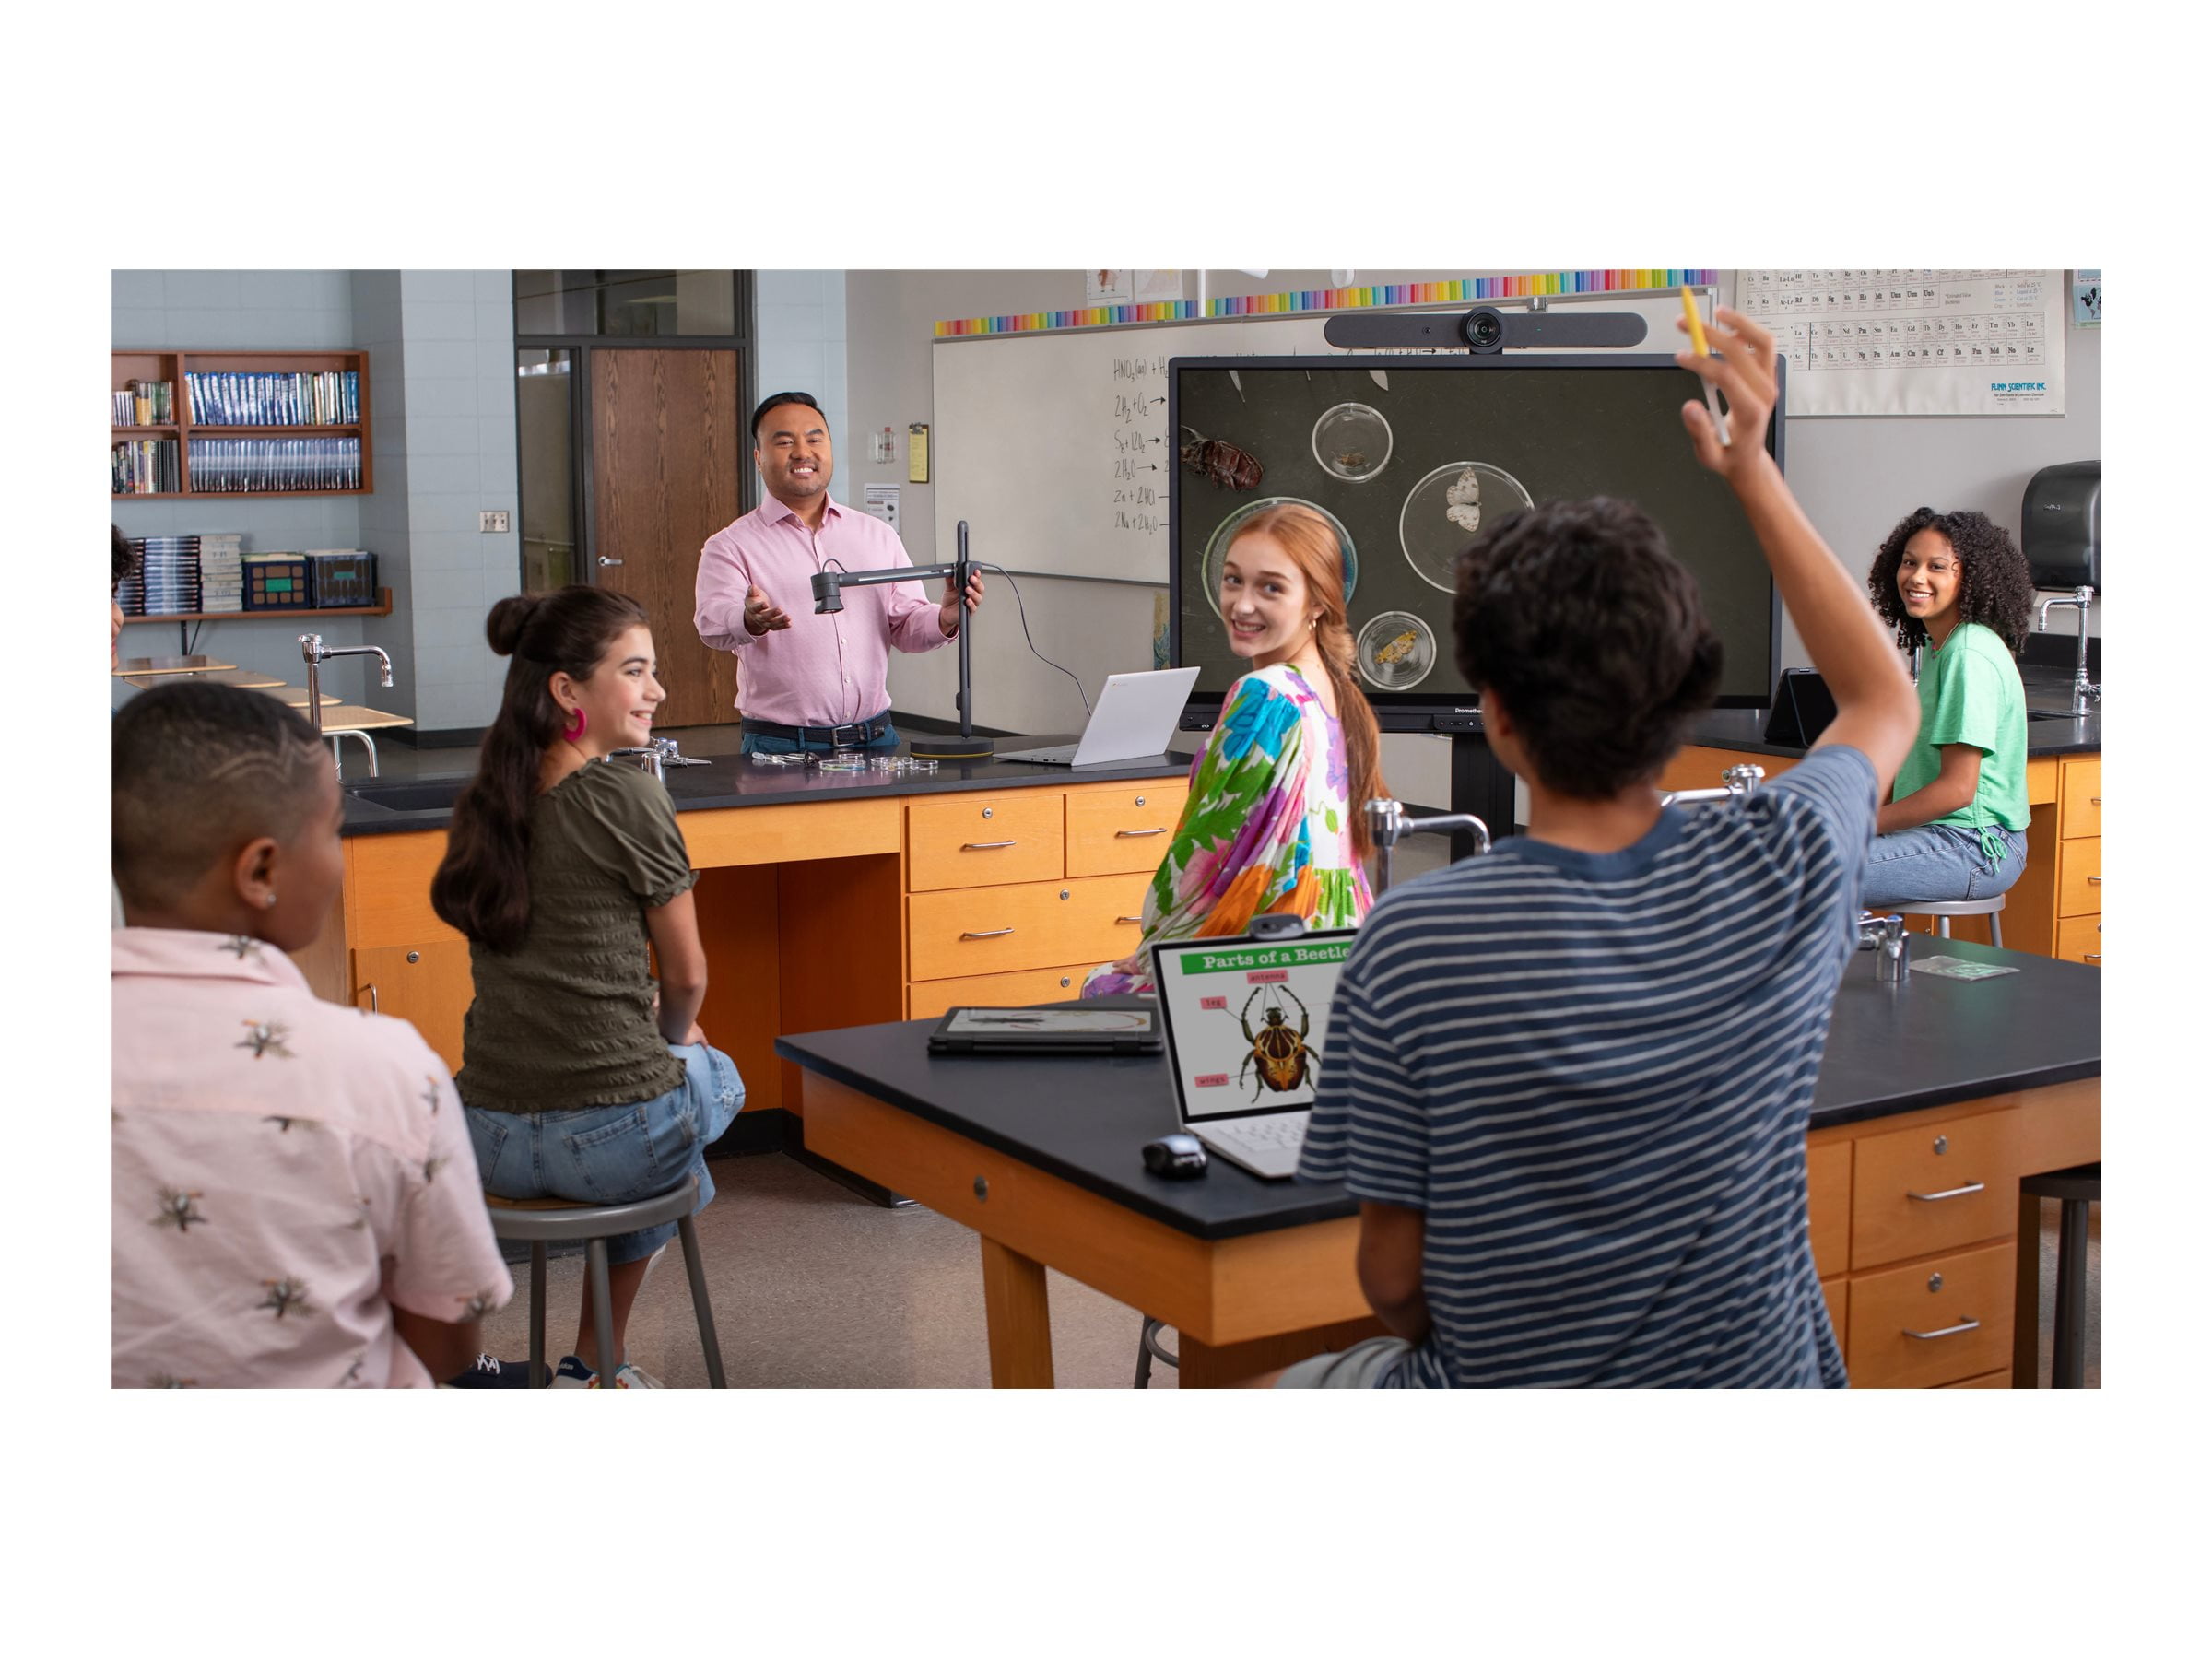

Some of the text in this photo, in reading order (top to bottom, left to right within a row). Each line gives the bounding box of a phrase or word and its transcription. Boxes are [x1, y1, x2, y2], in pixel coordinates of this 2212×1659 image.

[1203, 954, 1254, 968] Parts
[1259, 951, 1277, 964] of
[1281, 953, 1291, 962] a
